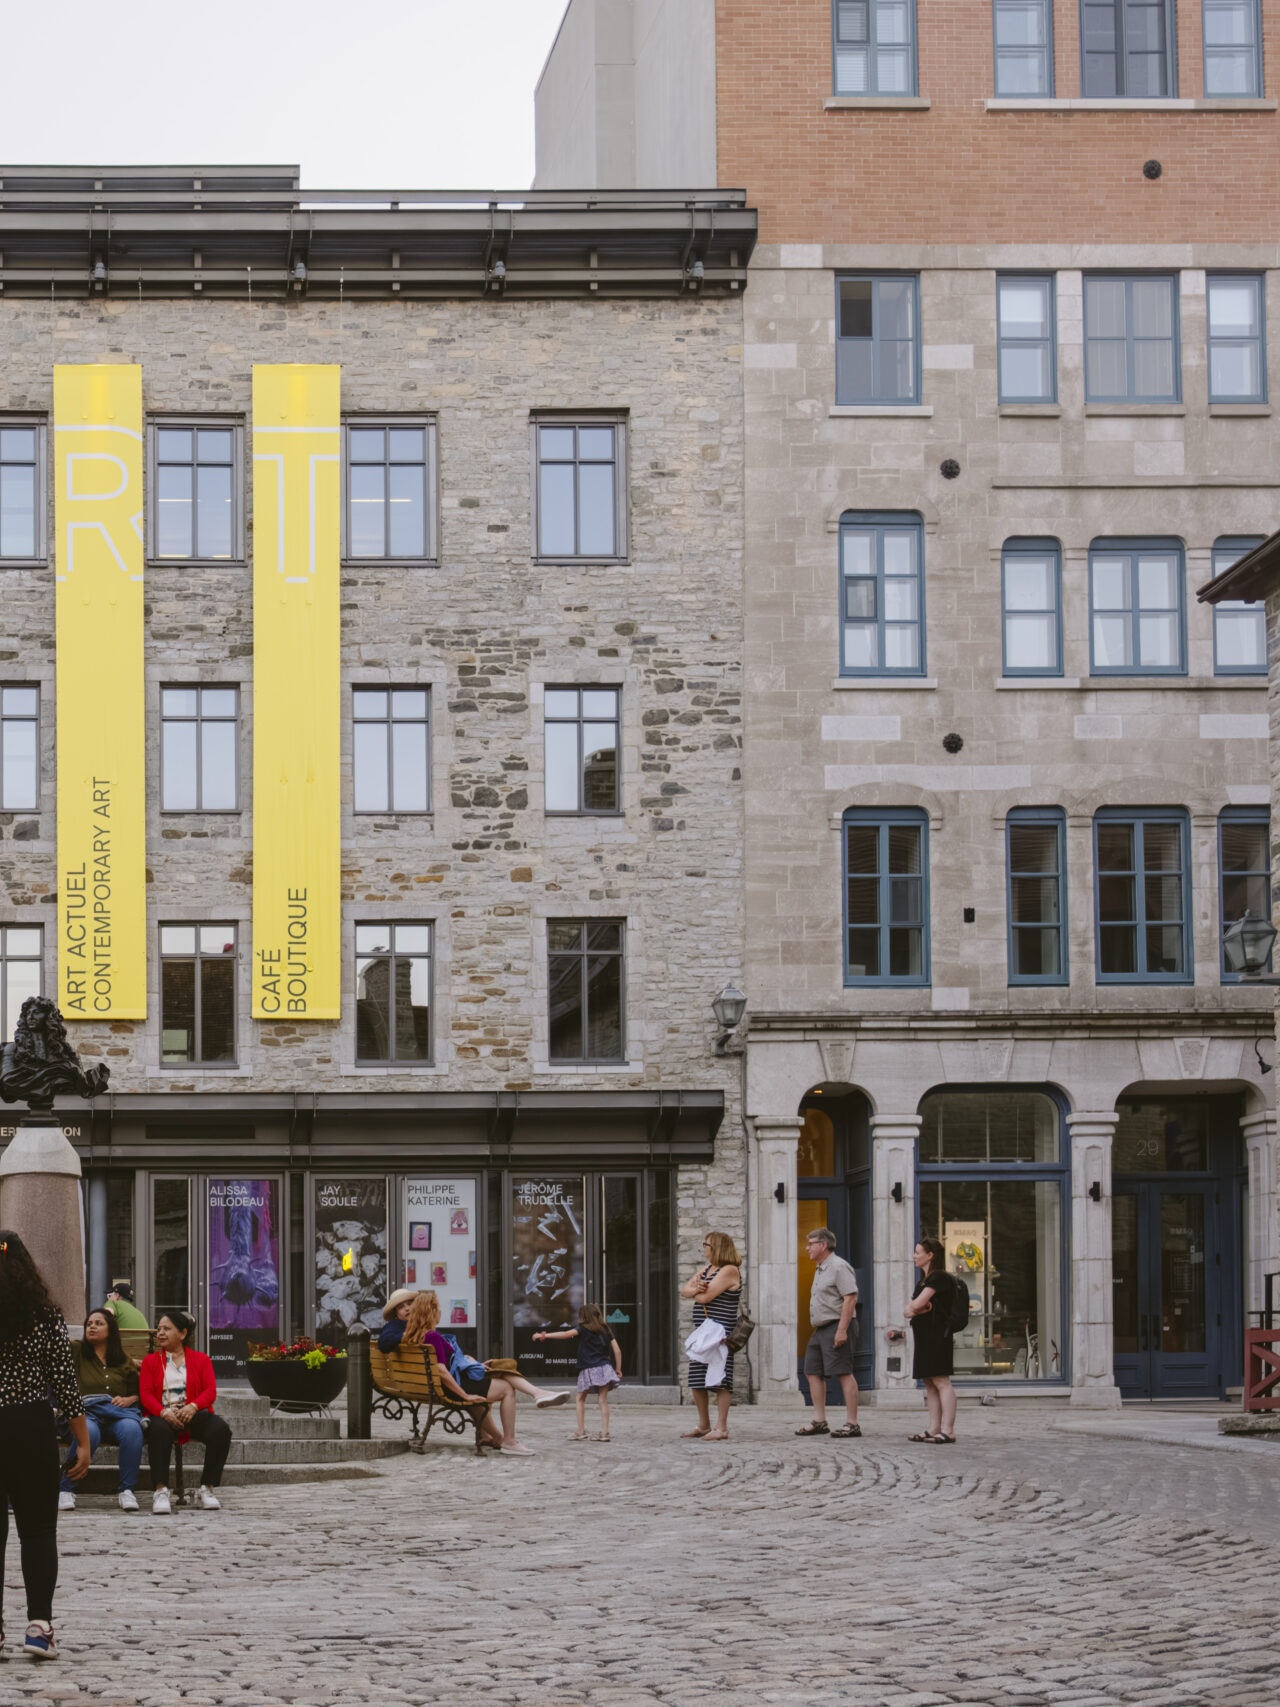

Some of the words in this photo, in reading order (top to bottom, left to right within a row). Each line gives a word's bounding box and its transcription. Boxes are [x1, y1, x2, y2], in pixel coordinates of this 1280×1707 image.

[93, 776, 111, 818] ART
[66, 862, 86, 958] ACTUEL
[93, 825, 112, 1012] CONTEMPORARY
[287, 888, 307, 1012] BOUTIQUE
[256, 948, 281, 1013] CAFÉ
[66, 966, 86, 1012] ART
[209, 1185, 248, 1195] ALISSA
[320, 1185, 341, 1195] JAY
[407, 1185, 455, 1194] PHILIPPE
[518, 1182, 563, 1194] JÉRÔME
[209, 1197, 264, 1207] BILODEAU
[320, 1197, 358, 1207] SOULE
[407, 1196, 460, 1205] KATERINE
[518, 1196, 573, 1205] TRUDELLE
